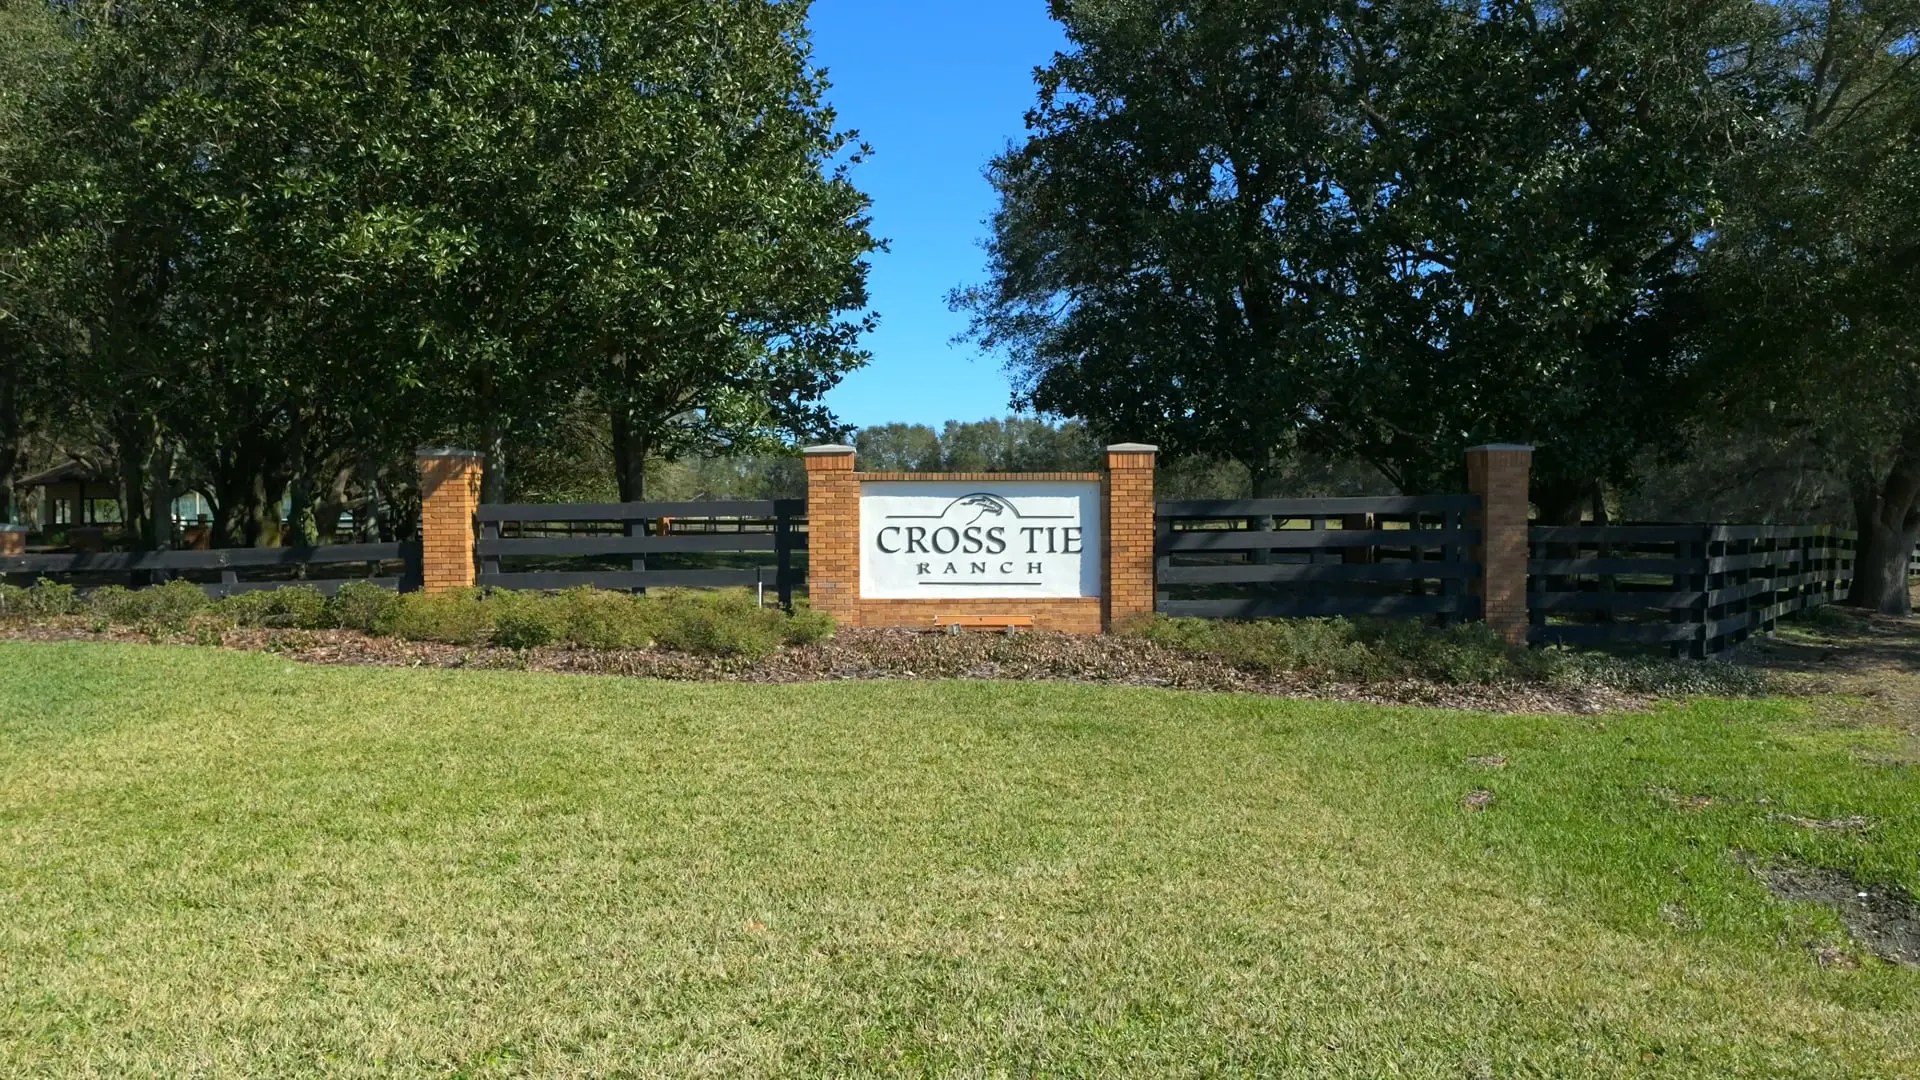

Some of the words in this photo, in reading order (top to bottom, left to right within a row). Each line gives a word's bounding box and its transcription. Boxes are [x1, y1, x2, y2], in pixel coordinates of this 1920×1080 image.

[877, 526, 1006, 554] CROSS
[1019, 527, 1083, 554] TIE
[917, 562, 1042, 575] RANCH
